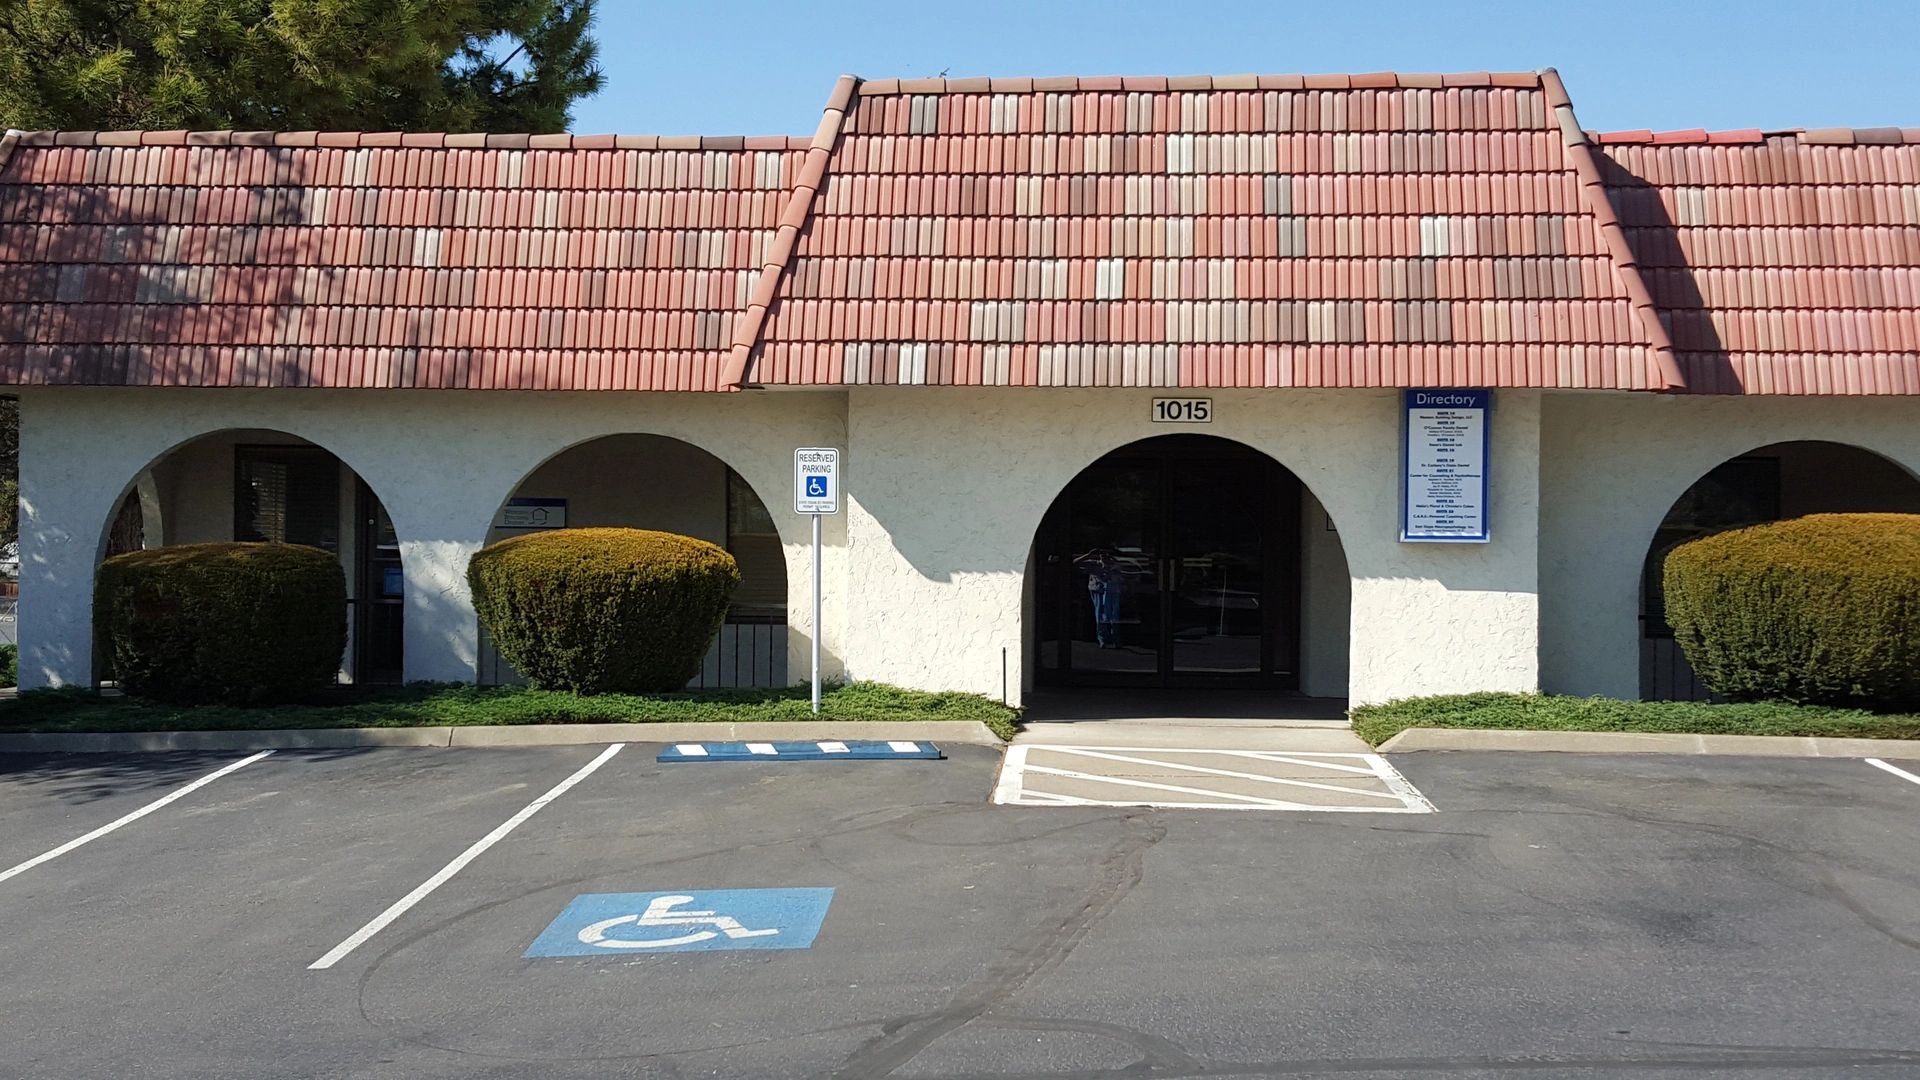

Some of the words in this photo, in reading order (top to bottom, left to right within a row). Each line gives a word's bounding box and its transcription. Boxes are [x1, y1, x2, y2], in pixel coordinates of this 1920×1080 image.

[1416, 393, 1476, 407] Directory
[1156, 401, 1208, 420] 1015
[799, 454, 834, 462] RESERVED
[802, 464, 832, 473] PARKING
